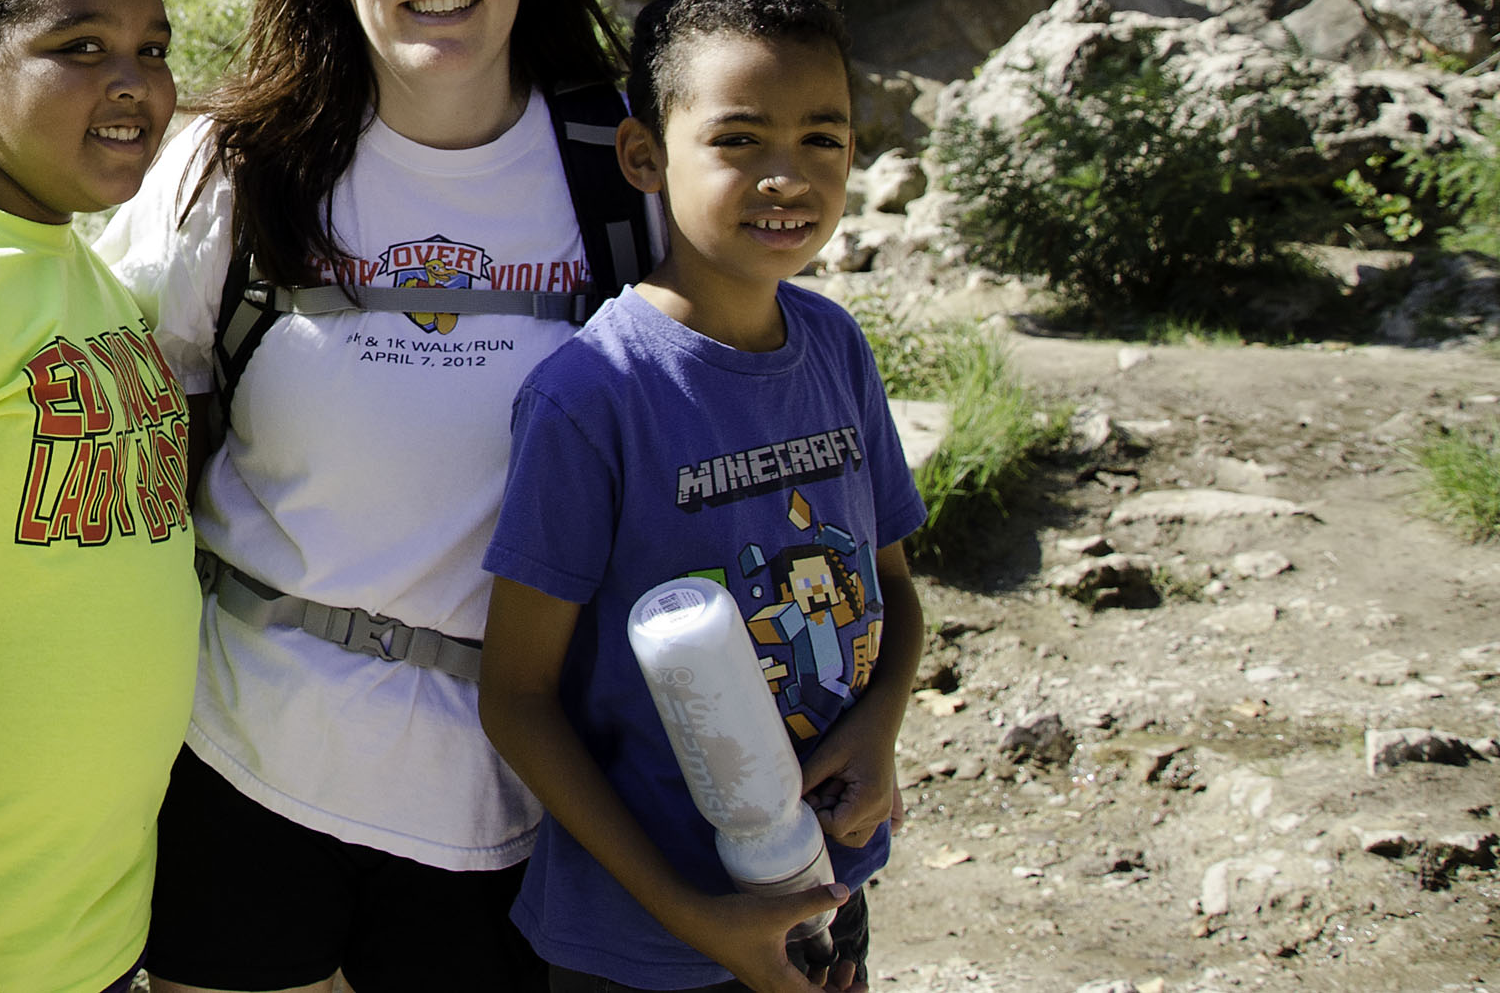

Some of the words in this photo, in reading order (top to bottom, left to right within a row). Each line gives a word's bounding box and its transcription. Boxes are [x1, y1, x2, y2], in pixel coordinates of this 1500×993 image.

[393, 245, 477, 272] OVER
[490, 260, 587, 292] VIOLEN
[360, 351, 414, 365] APRIL
[421, 356, 435, 367] 7,
[443, 356, 486, 367] 2012
[365, 336, 378, 347] &
[387, 338, 406, 350] 1K
[412, 340, 514, 353] WALK/RUN
[14, 431, 136, 547] LADY
[676, 426, 864, 508] MINECRAFT
